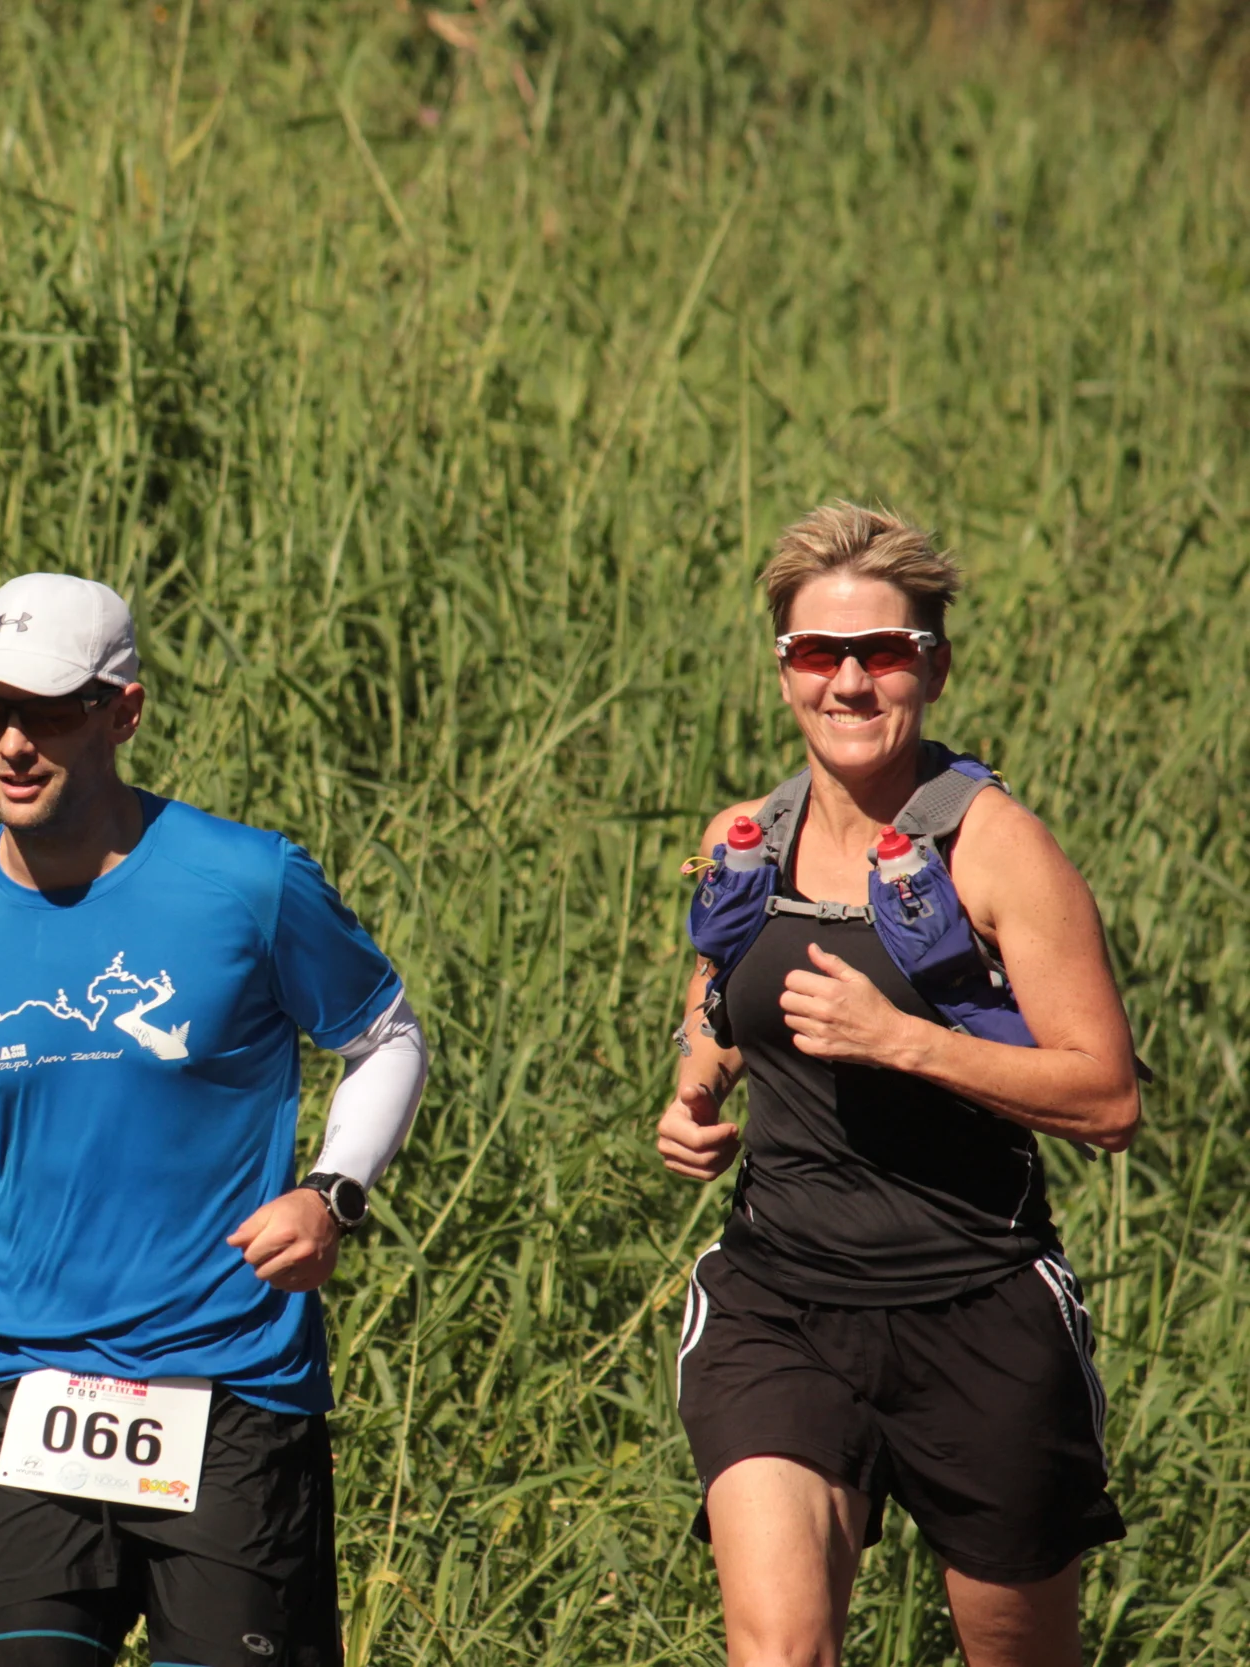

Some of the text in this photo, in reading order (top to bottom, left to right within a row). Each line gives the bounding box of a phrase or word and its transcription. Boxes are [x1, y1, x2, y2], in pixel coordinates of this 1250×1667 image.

[10, 1044, 26, 1052] ONE
[11, 1050, 27, 1058] ONE
[36, 1055, 66, 1066] New
[71, 1049, 123, 1061] Zealand
[42, 1405, 163, 1467] 066
[138, 1477, 190, 1498] BOOST
